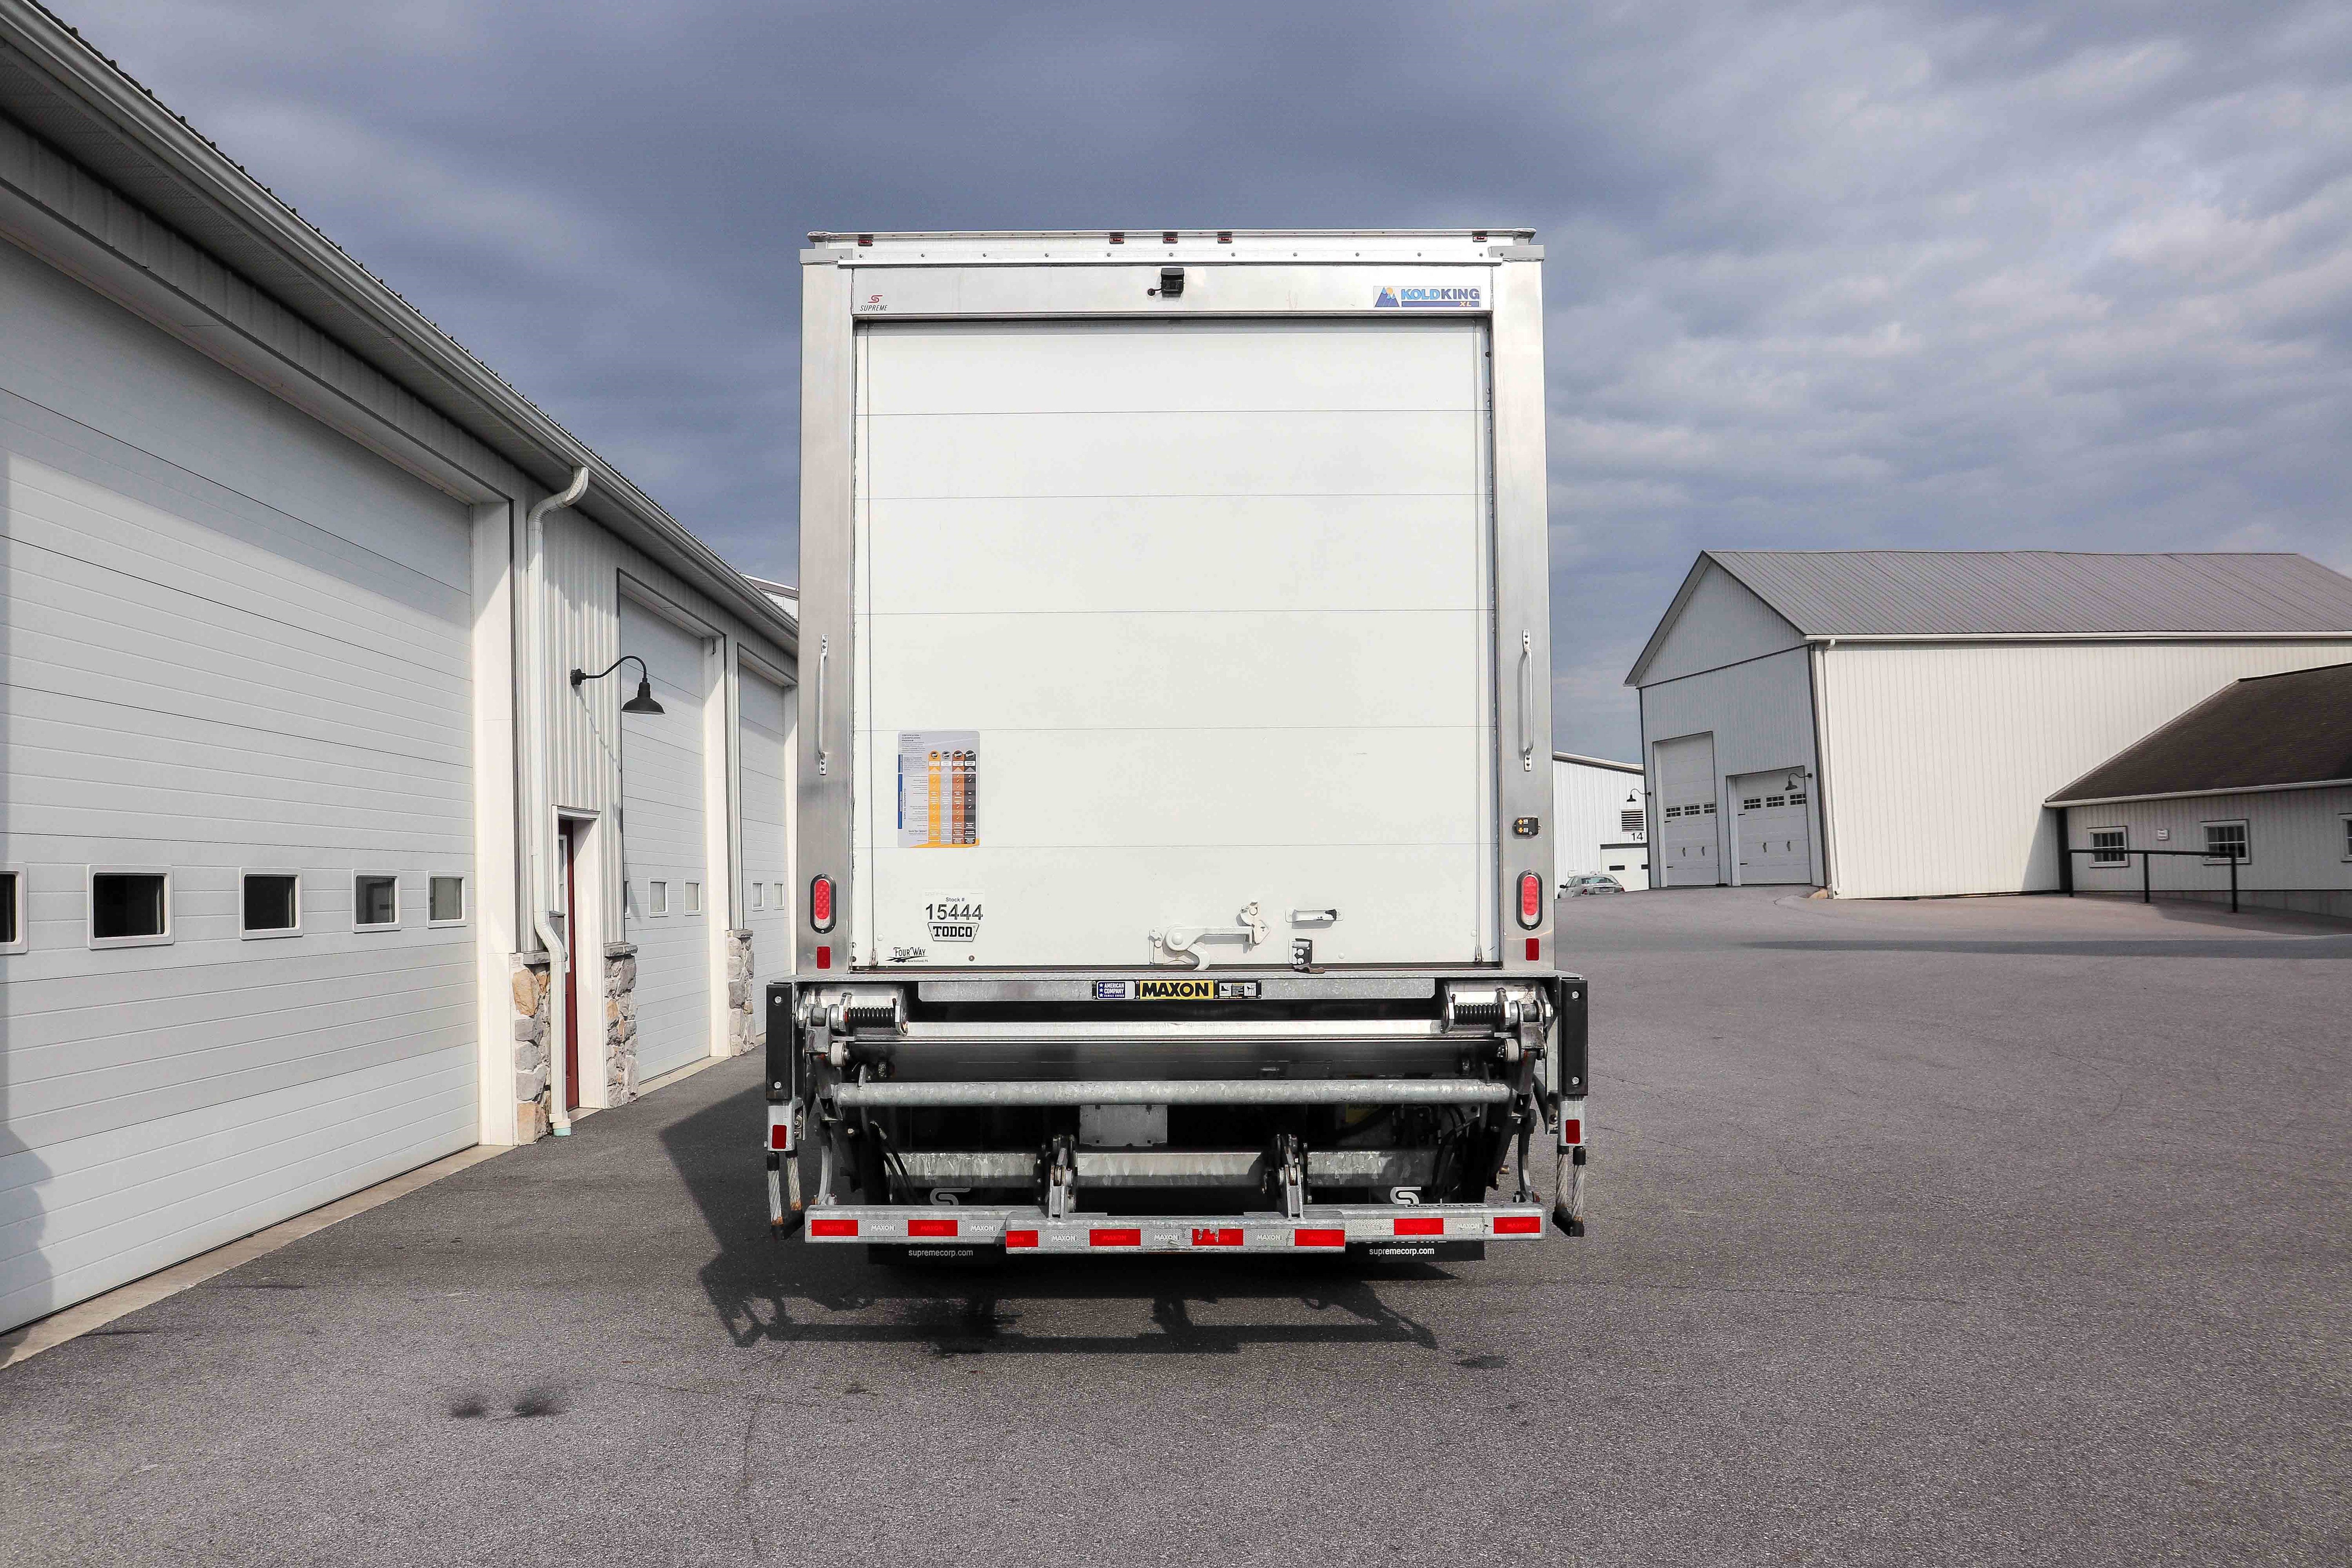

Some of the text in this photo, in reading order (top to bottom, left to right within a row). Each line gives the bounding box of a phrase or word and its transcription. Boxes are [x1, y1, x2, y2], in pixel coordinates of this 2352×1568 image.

[1401, 289, 1480, 299] KOLDKING
[1631, 832, 1643, 841] 14
[926, 904, 983, 920] 15444
[933, 926, 972, 937] TODCO
[1142, 982, 1209, 997] MAXON
[908, 1250, 973, 1258] supremecorp.com
[1369, 1248, 1435, 1256] supremecorp.com
